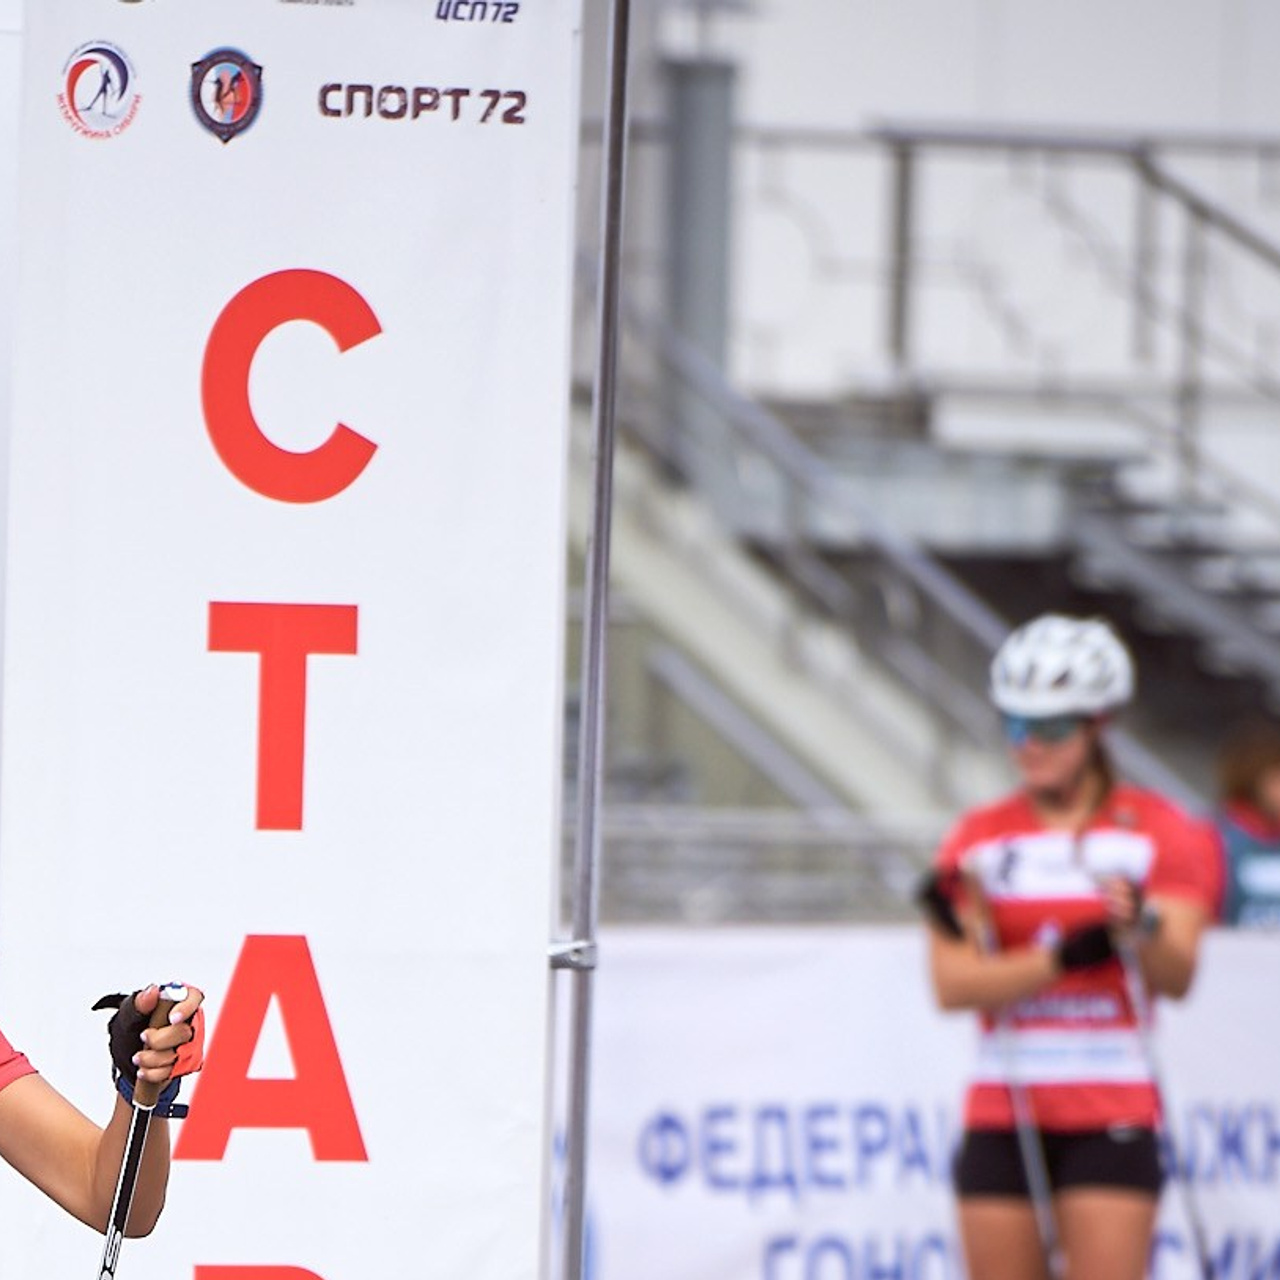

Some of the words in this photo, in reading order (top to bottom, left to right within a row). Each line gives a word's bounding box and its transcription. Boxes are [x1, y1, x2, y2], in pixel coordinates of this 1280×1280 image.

[318, 83, 470, 120] СПОРТ
[480, 89, 526, 124] 72
[637, 1102, 953, 1203] ФЕДЕРА
